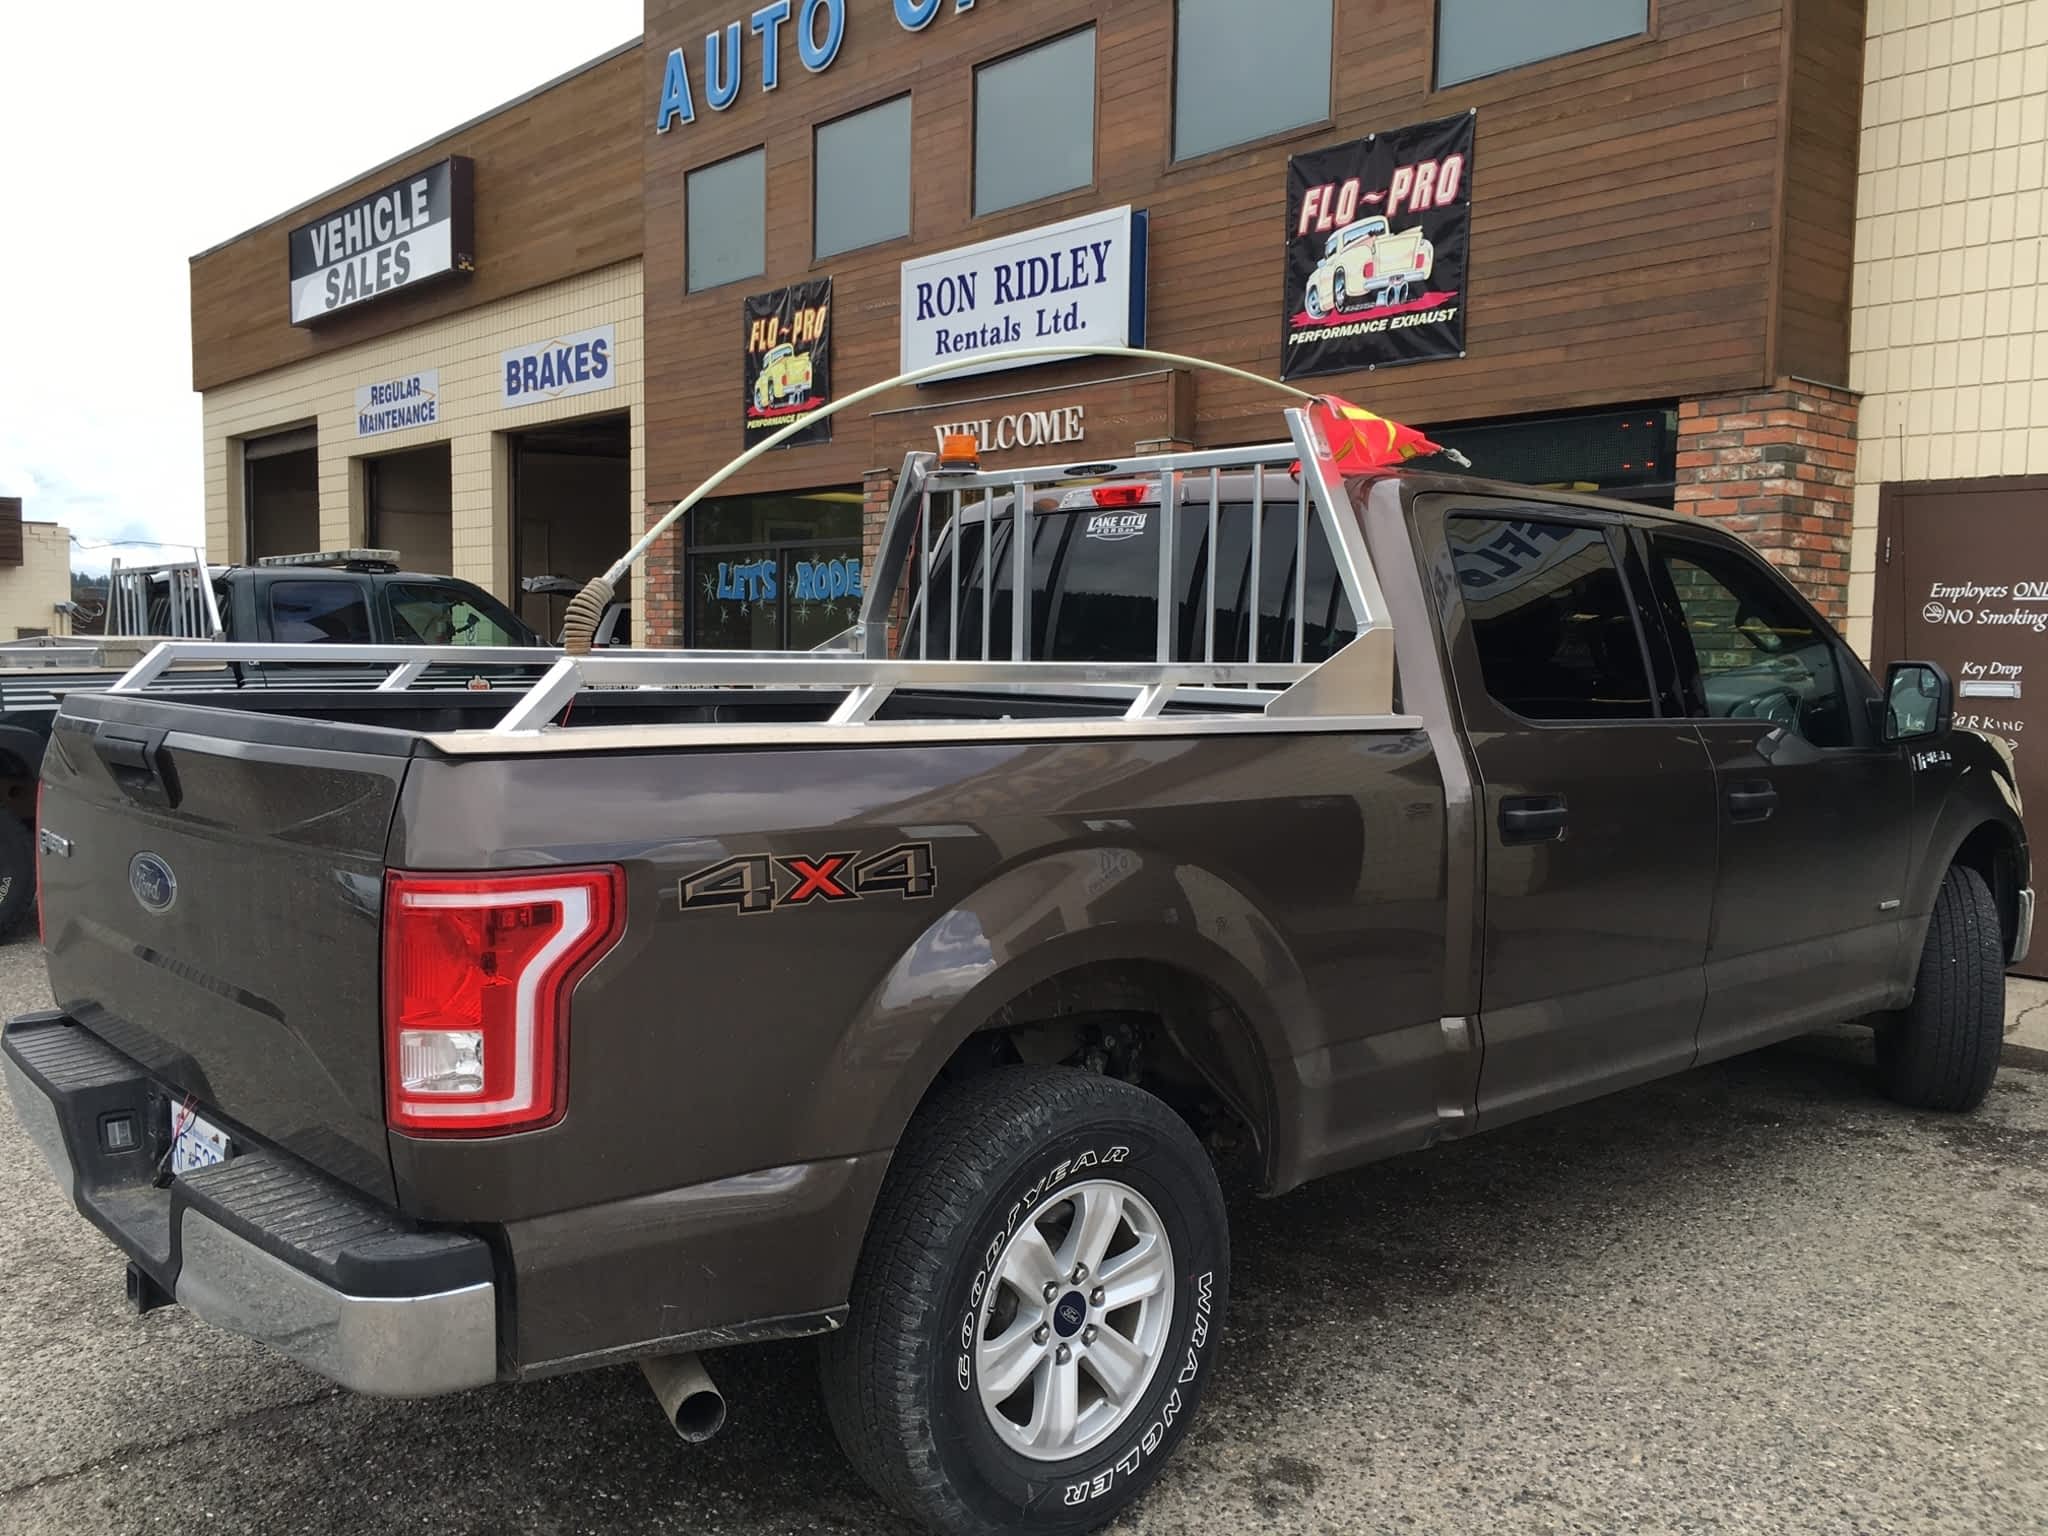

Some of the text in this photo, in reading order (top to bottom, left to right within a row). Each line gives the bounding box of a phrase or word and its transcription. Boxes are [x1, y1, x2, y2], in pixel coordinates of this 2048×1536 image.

[656, 0, 846, 135] AUTO
[310, 178, 430, 268] VEHICLE
[325, 240, 411, 309] SALES
[916, 240, 1112, 321] RON RIDLEY
[935, 301, 1086, 355] Rentals Ltd.
[1288, 307, 1457, 345] PERFORMANCE EXHAUST
[371, 377, 421, 406] REGULAR
[506, 338, 608, 396] BRAKES
[359, 401, 436, 435] MAINTENANCE
[1086, 513, 1147, 532] LAKE CITY
[1930, 581, 2009, 604] Employees
[1944, 608, 2048, 633] NO Smoking
[1961, 662, 2023, 680] Key Drop
[957, 1146, 1130, 1391] GOODYEAR
[1063, 1271, 1213, 1506] WRANGLER
